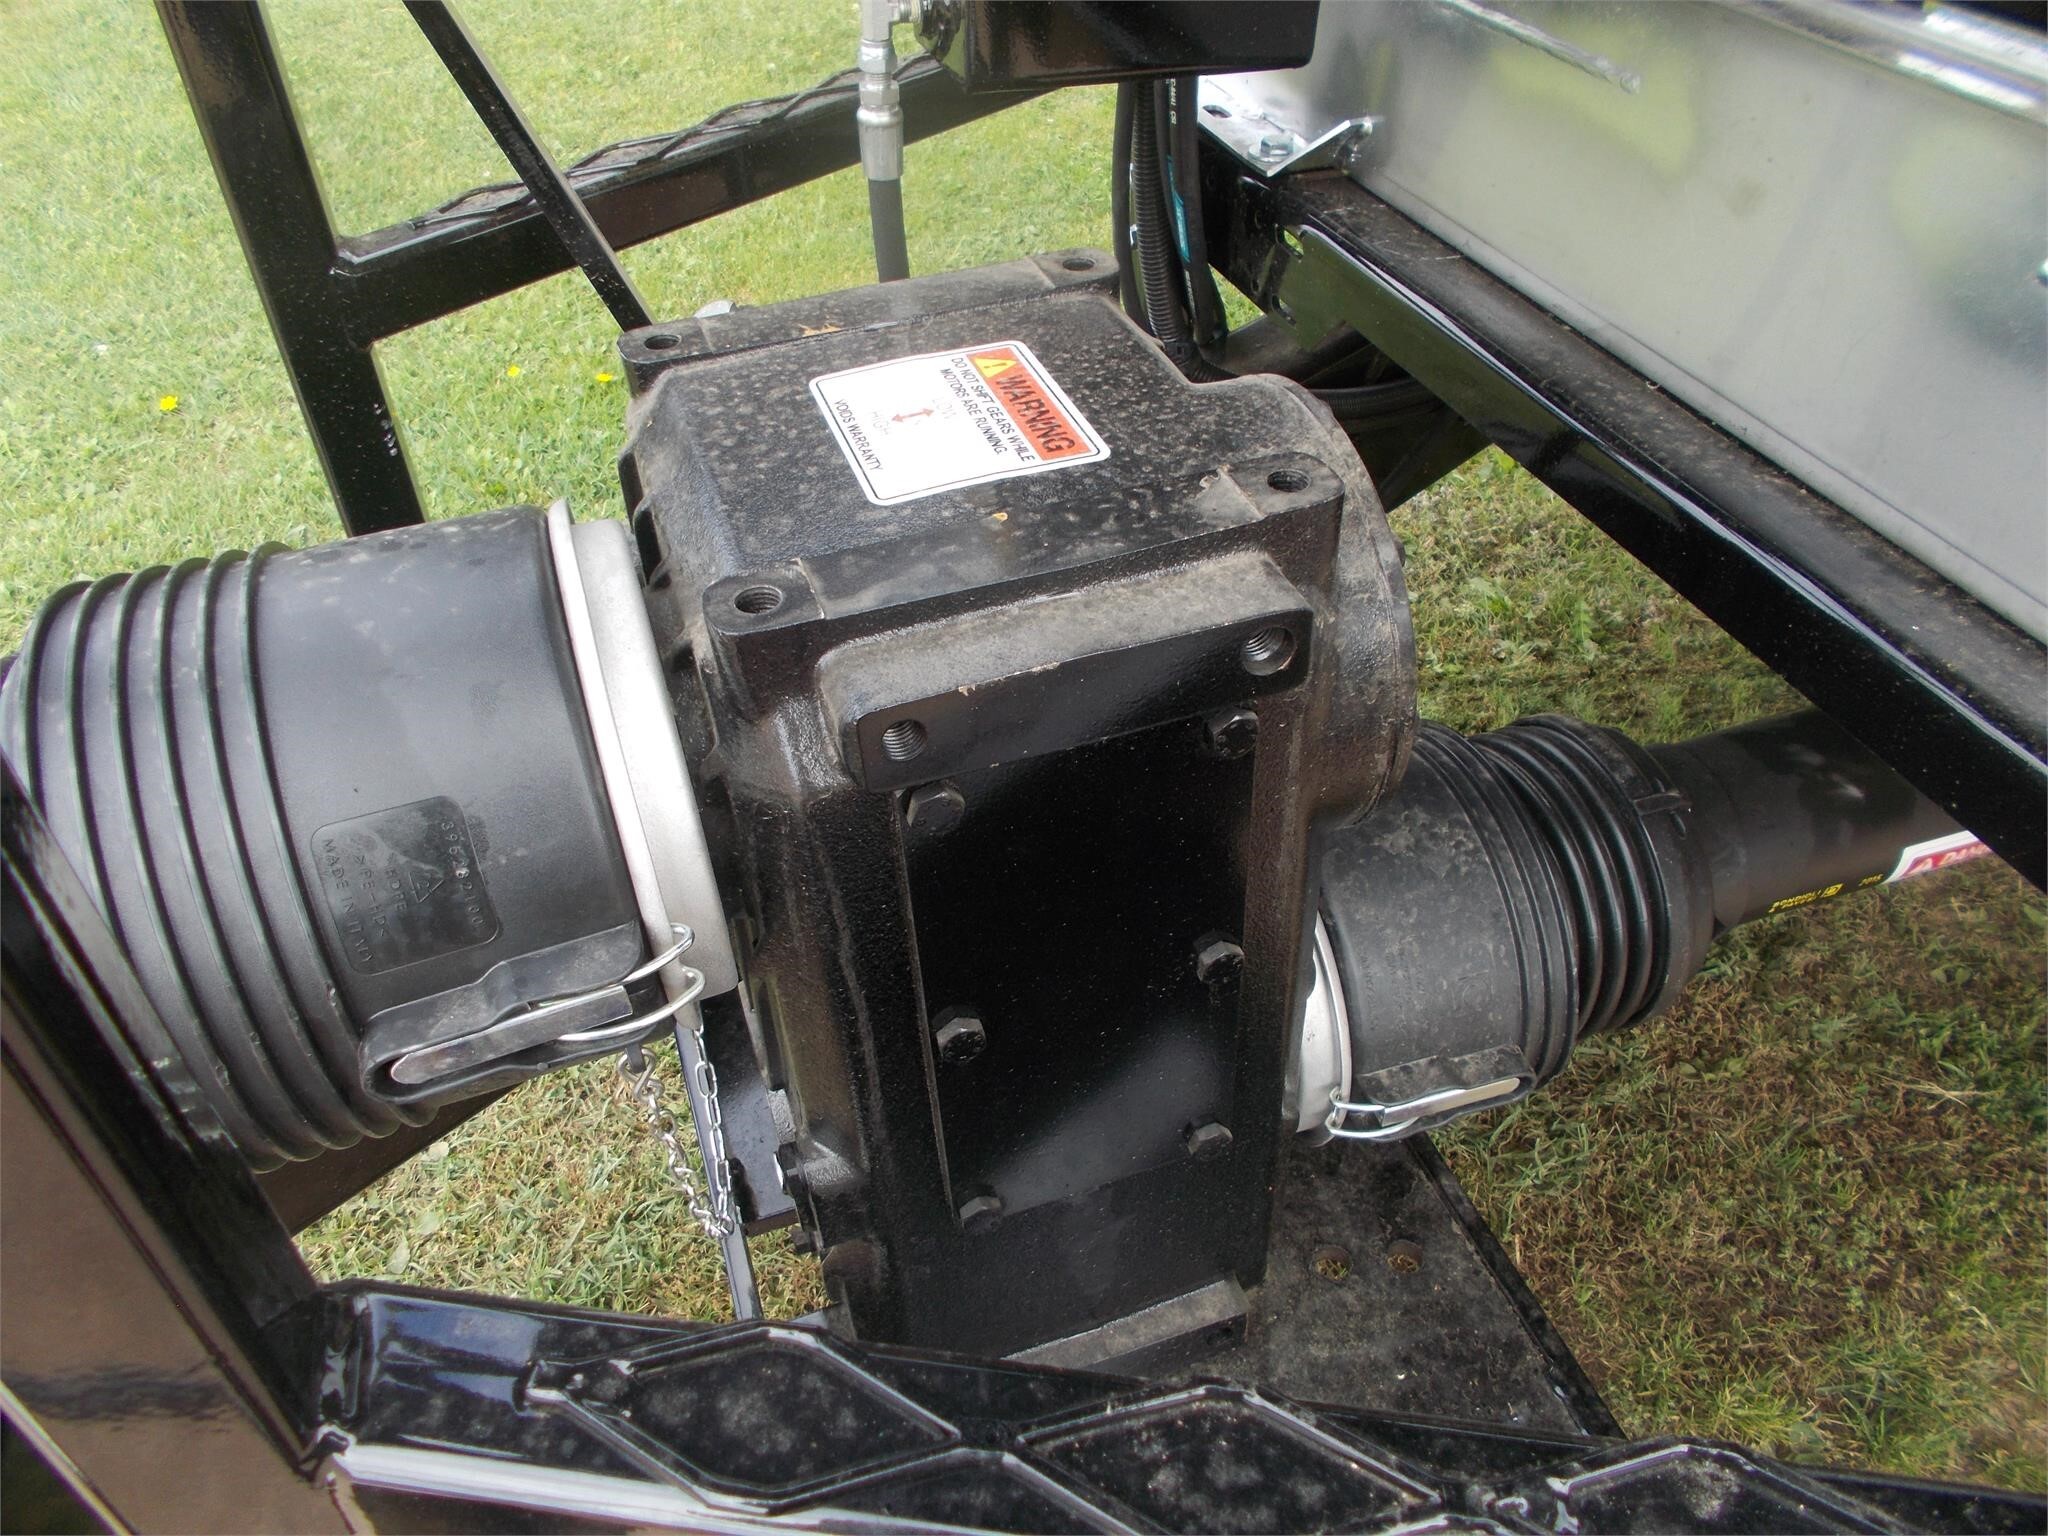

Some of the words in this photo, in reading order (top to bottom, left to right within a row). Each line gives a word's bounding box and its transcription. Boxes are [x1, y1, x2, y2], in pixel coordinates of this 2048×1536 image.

[940, 368, 970, 399] MOTORS
[961, 399, 982, 416] ARE
[951, 357, 968, 369] DO
[960, 368, 979, 384] NOT
[971, 385, 995, 404] SHIFT
[987, 406, 1015, 434] GEARS
[1009, 435, 1036, 462] WHILE
[996, 374, 1075, 453] WARNING
[834, 399, 856, 424] VOIDS
[847, 423, 883, 470] WARRANTY
[323, 838, 350, 889] MADE
[342, 896, 355, 914] IN
